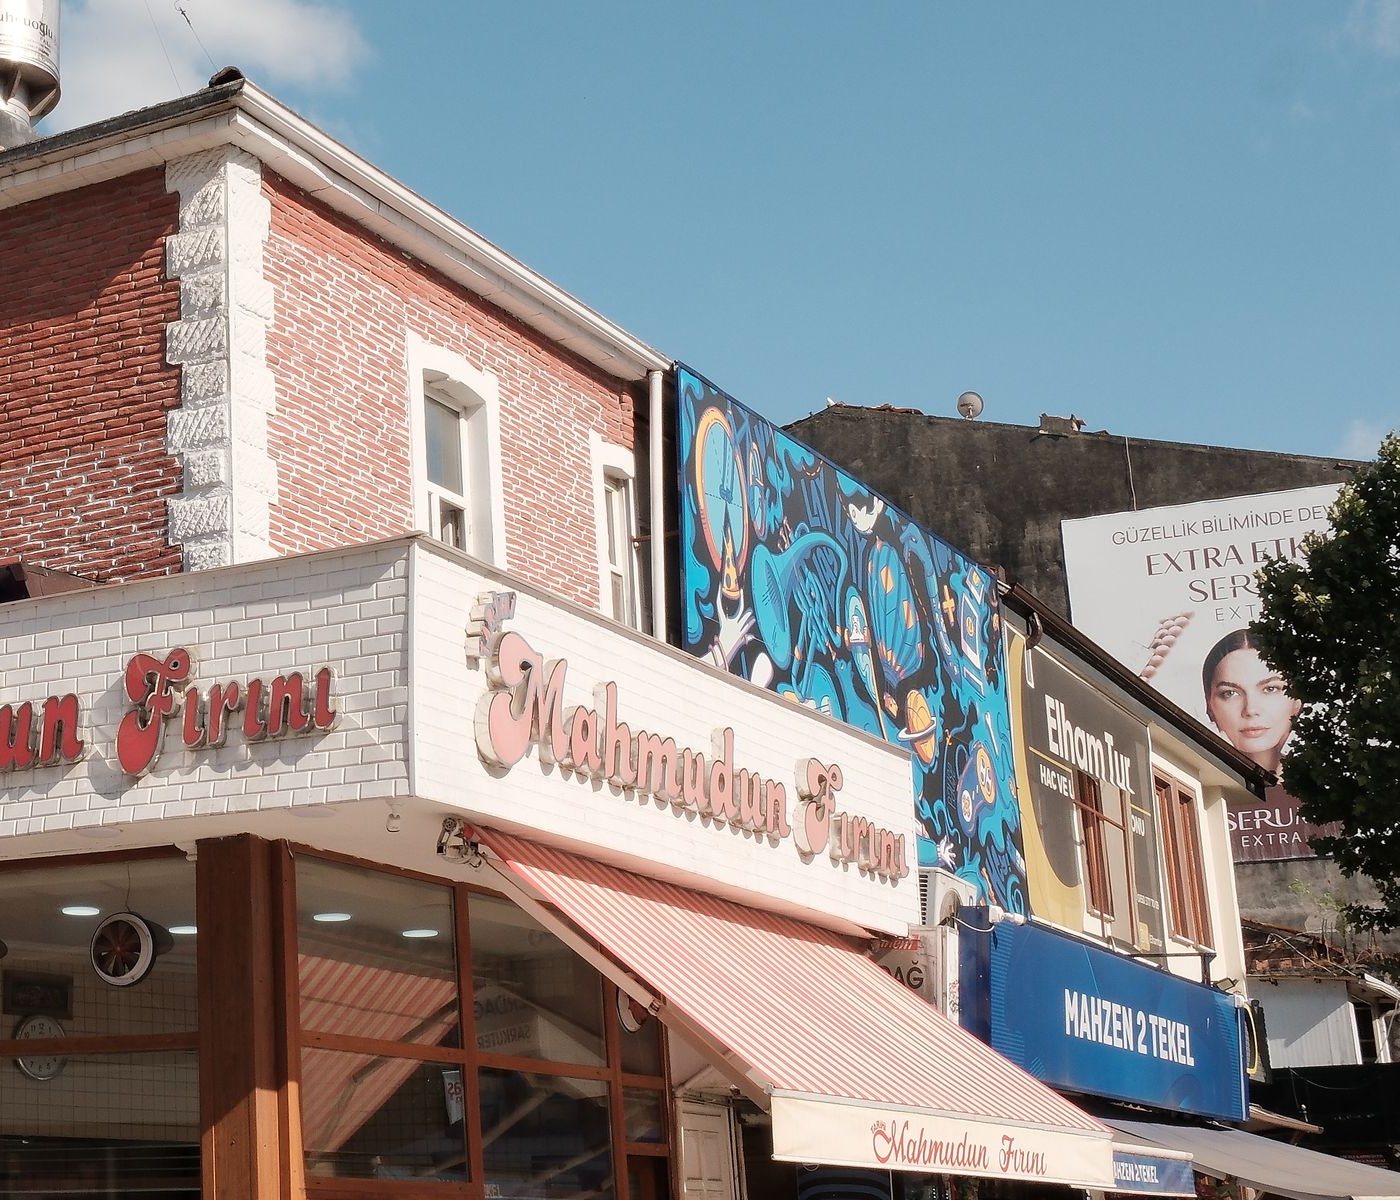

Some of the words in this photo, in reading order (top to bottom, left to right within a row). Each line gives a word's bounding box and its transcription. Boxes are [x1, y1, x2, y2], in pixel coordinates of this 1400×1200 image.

[1112, 519, 1198, 545] GÜZELLİK
[1202, 510, 1294, 534] BİLİMİNDE
[1146, 544, 1244, 576] EXTRA
[1188, 574, 1260, 602] SER
[1215, 604, 1256, 621] EXT
[116, 647, 341, 776] Fırını
[478, 631, 791, 839] Mahmudun
[799, 757, 910, 879] Fırını
[1044, 693, 1107, 781] Elham
[1104, 731, 1135, 795] Tur
[1040, 763, 1057, 790] HAC
[1057, 773, 1069, 797] VE
[1242, 832, 1302, 847] EXTRA
[880, 959, 924, 990] AĞ
[1064, 988, 1134, 1051] MAHZEN
[1136, 1010, 1147, 1055] 2
[1148, 1014, 1195, 1067] TEKEL
[872, 1119, 989, 1170] Mahmudun
